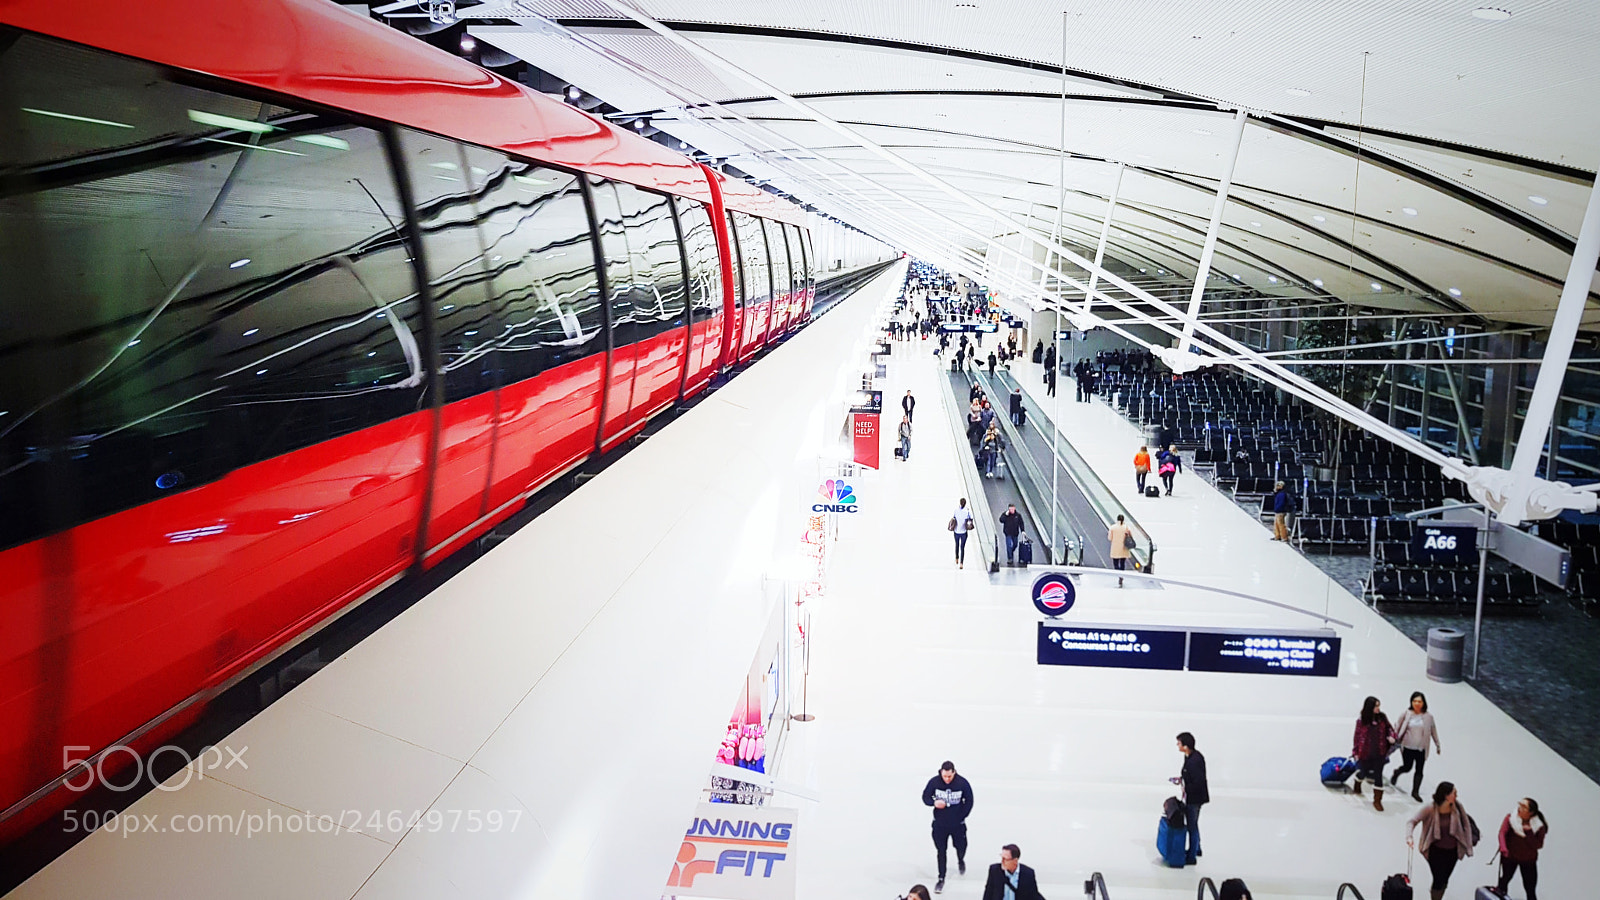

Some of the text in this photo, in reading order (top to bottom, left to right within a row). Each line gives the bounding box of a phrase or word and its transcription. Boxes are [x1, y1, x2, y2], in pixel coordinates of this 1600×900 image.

[812, 504, 858, 513] CNBC
[1424, 535, 1457, 550] A66
[1087, 632, 1099, 641] A1
[1100, 633, 1110, 641] to
[1116, 643, 1132, 651] and
[1134, 644, 1140, 652] C
[1279, 639, 1315, 649] Terminal
[1253, 648, 1289, 659] Luggage
[1290, 650, 1314, 658] Claim
[1290, 659, 1313, 668] Hotel
[716, 849, 786, 878] FIT
